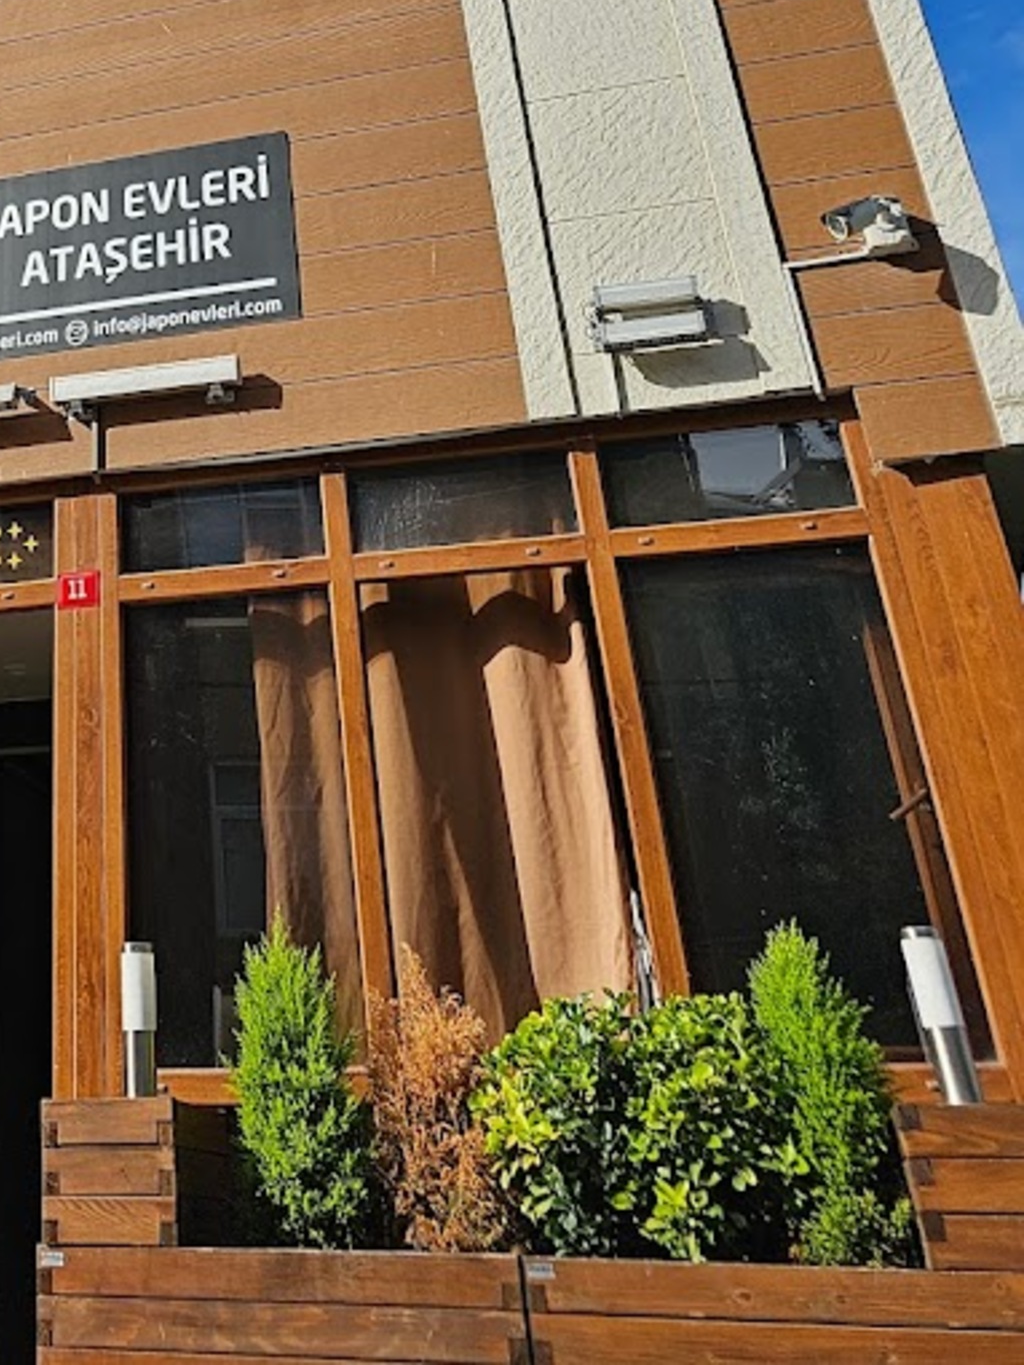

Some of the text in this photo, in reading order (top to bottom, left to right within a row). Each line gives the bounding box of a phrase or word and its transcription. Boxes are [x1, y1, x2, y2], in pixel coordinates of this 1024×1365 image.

[124, 154, 270, 220] EVLERİ
[20, 217, 232, 285] ATAŞEHİR
[93, 298, 282, 336] info@japonevleri.com
[68, 579, 88, 600] 11
